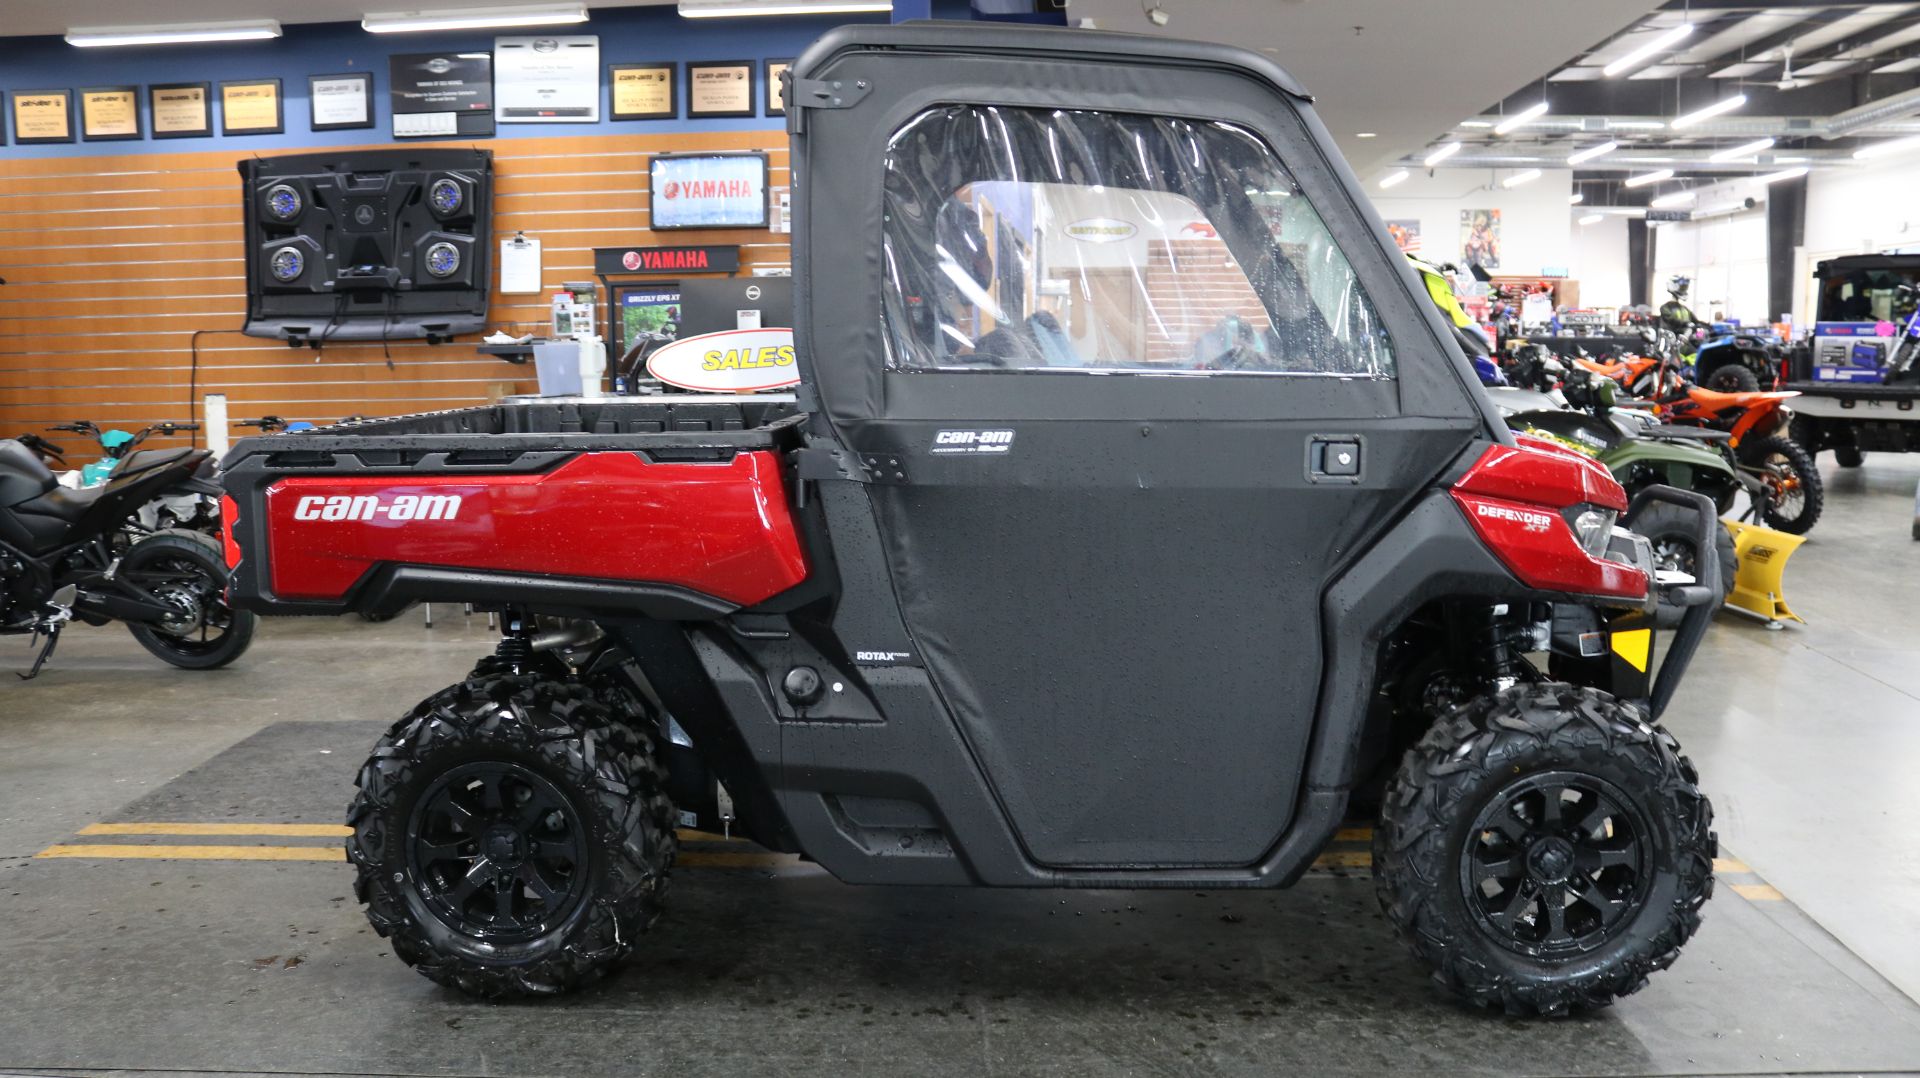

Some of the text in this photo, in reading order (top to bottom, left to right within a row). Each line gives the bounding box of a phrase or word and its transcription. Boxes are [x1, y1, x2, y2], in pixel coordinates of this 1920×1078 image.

[681, 180, 752, 198] YAMAHA
[641, 250, 708, 269] YAMAHA
[702, 345, 795, 371] SALES
[936, 431, 1013, 444] can-am
[294, 495, 462, 521] can-am
[1477, 505, 1551, 526] DEFENDER
[856, 651, 894, 661] ROTAX
